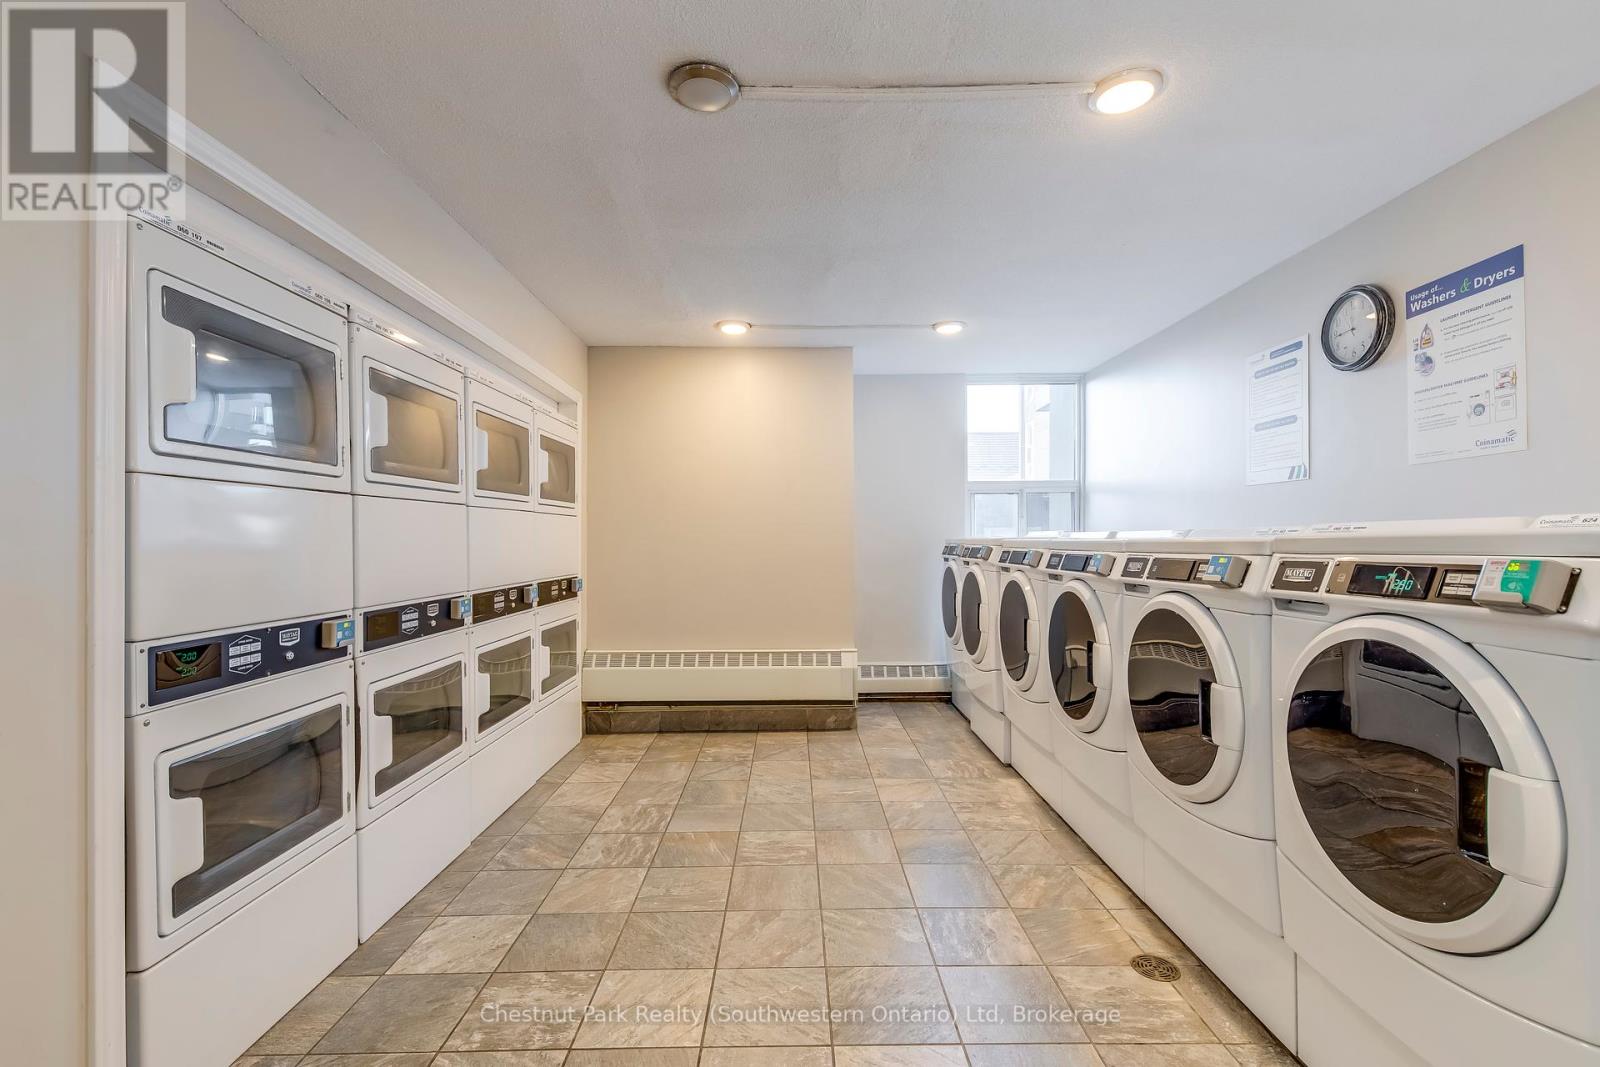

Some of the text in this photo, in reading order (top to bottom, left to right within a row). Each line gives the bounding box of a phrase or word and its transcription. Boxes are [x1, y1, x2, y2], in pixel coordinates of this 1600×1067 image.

[1410, 265, 1516, 312] Washers & Dryers
[1410, 289, 1430, 301] Usage
[1475, 435, 1515, 448] Coinamatic
[1286, 568, 1313, 578] MAYTAG
